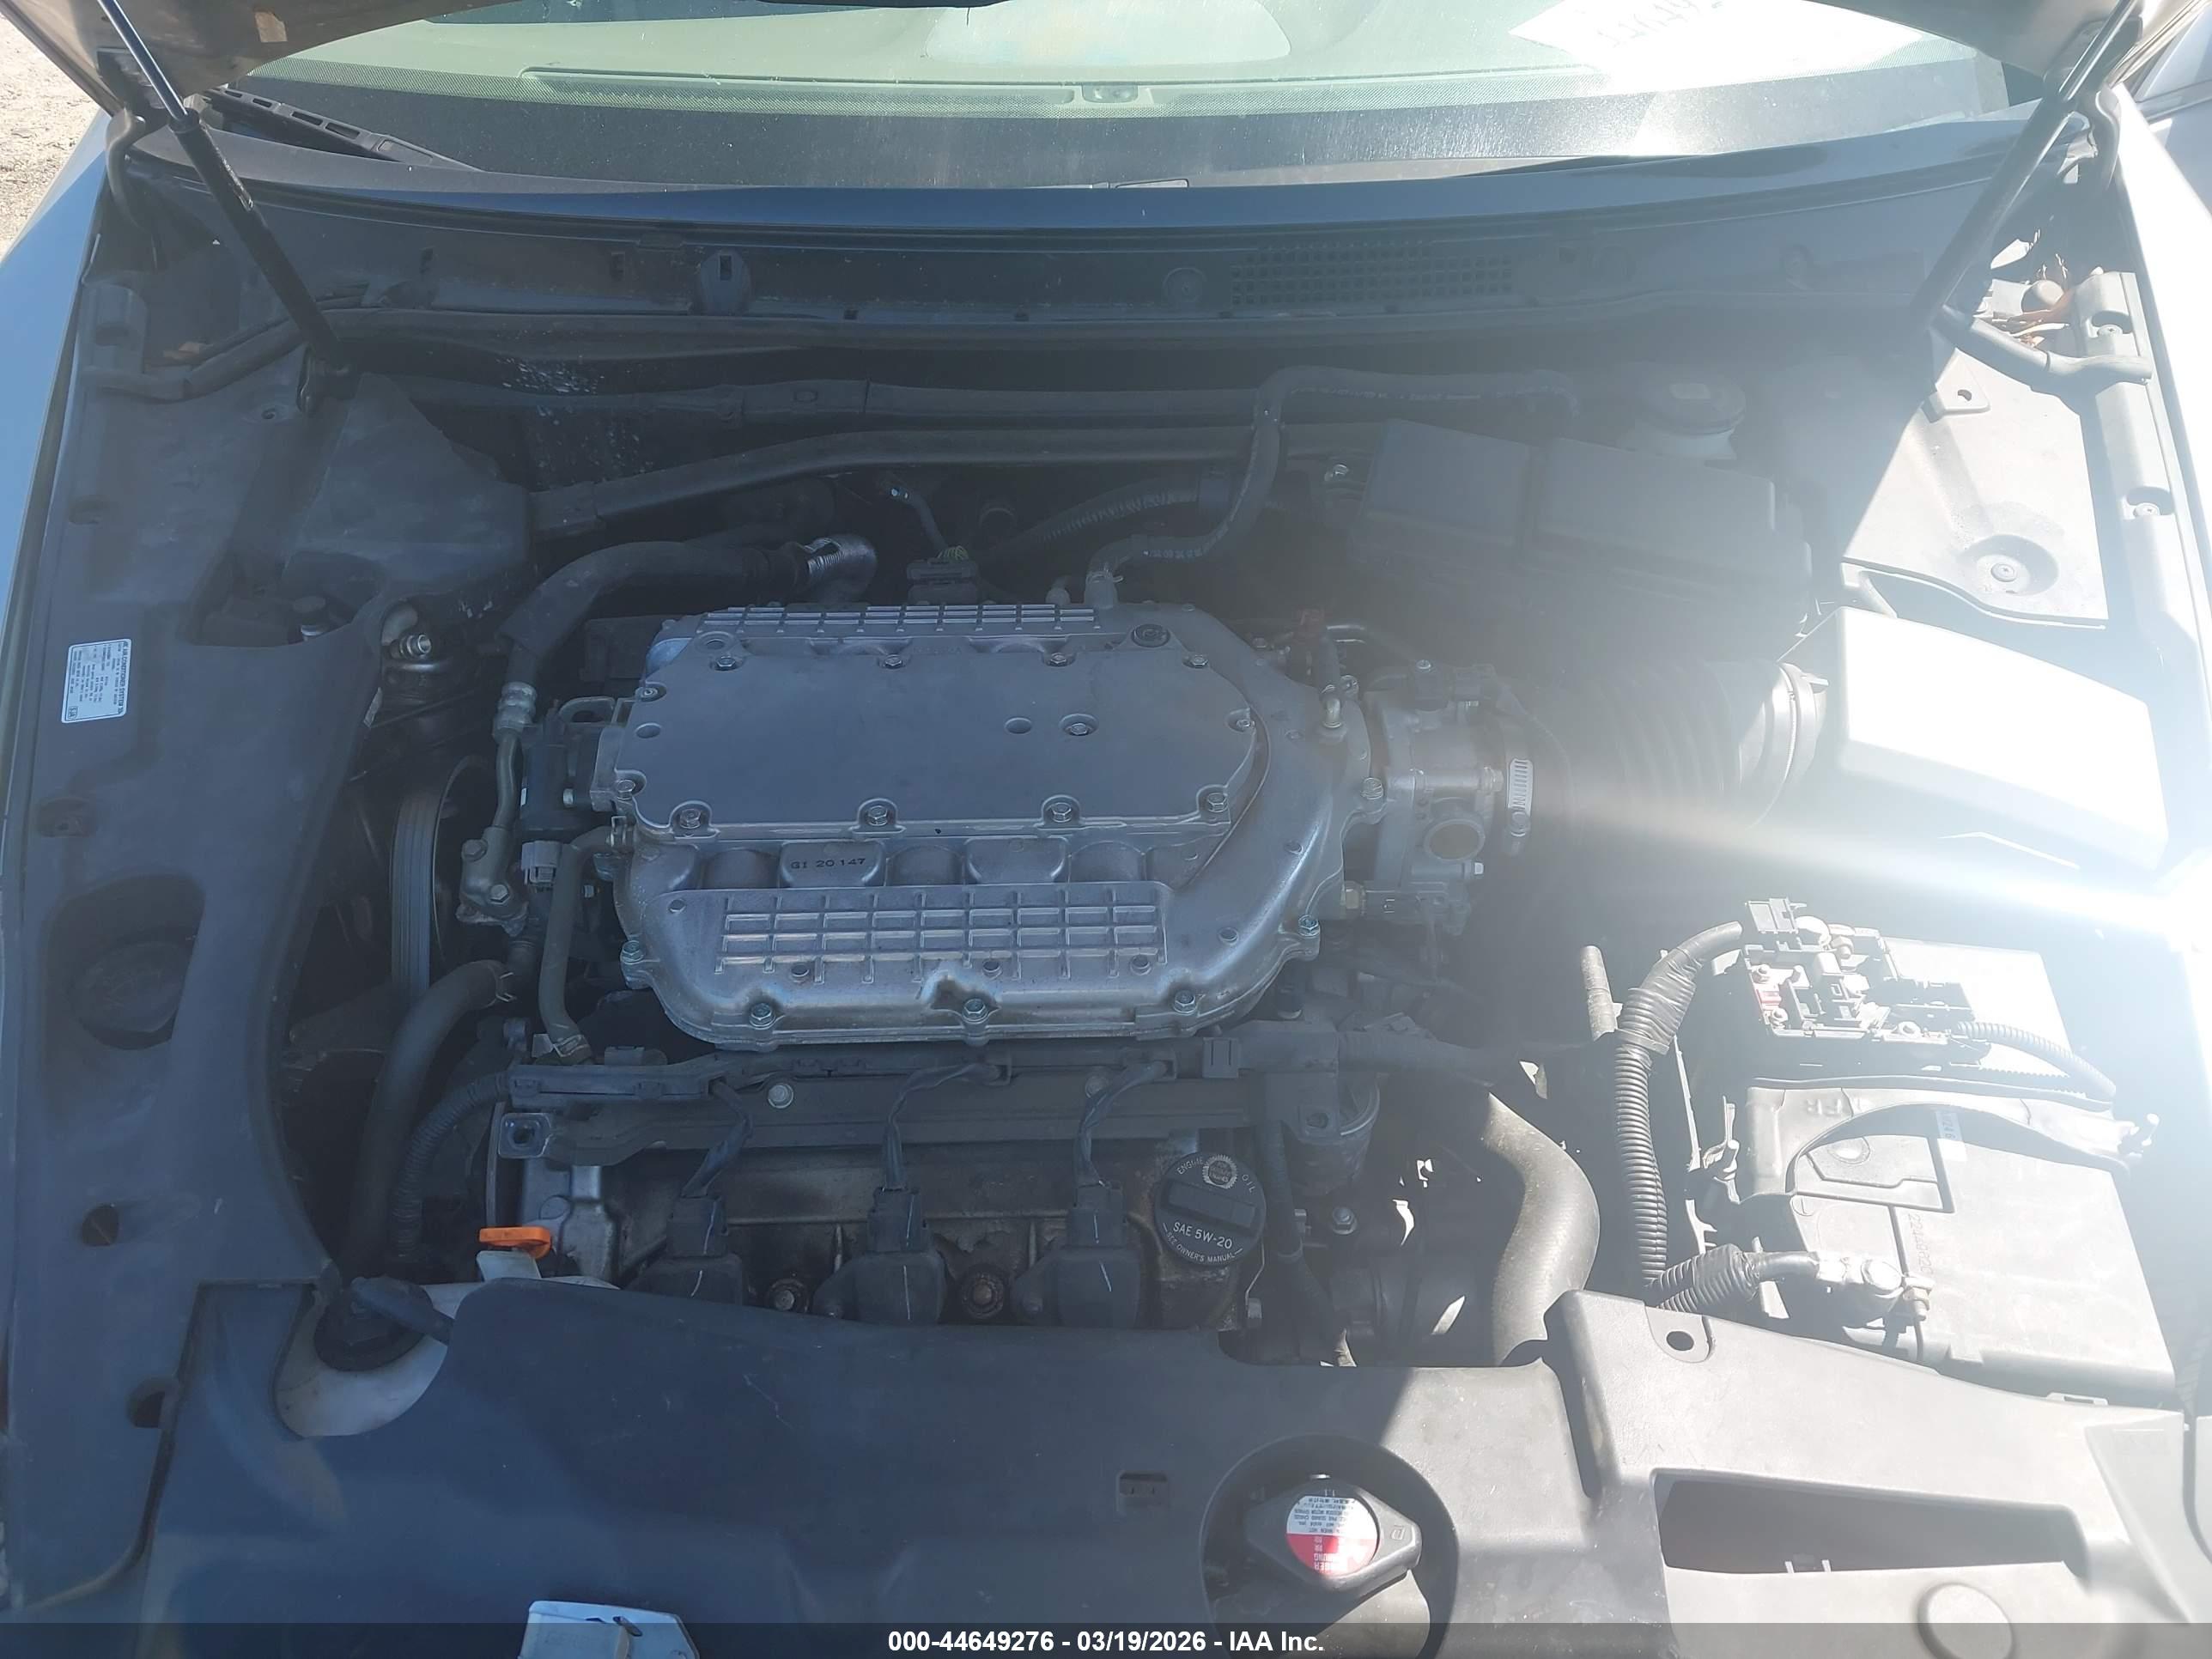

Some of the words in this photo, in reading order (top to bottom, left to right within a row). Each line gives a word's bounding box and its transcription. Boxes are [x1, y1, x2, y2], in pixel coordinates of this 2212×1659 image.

[1177, 1158, 1204, 1175] ENGINE
[1242, 1174, 1255, 1193] OIL
[1166, 1231, 1178, 1246] SEE
[1176, 1244, 1205, 1262] OWNER'S
[1207, 1253, 1235, 1263] MANUAL
[1173, 1222, 1193, 1237] SAE
[1194, 1229, 1232, 1249] 5W-20
